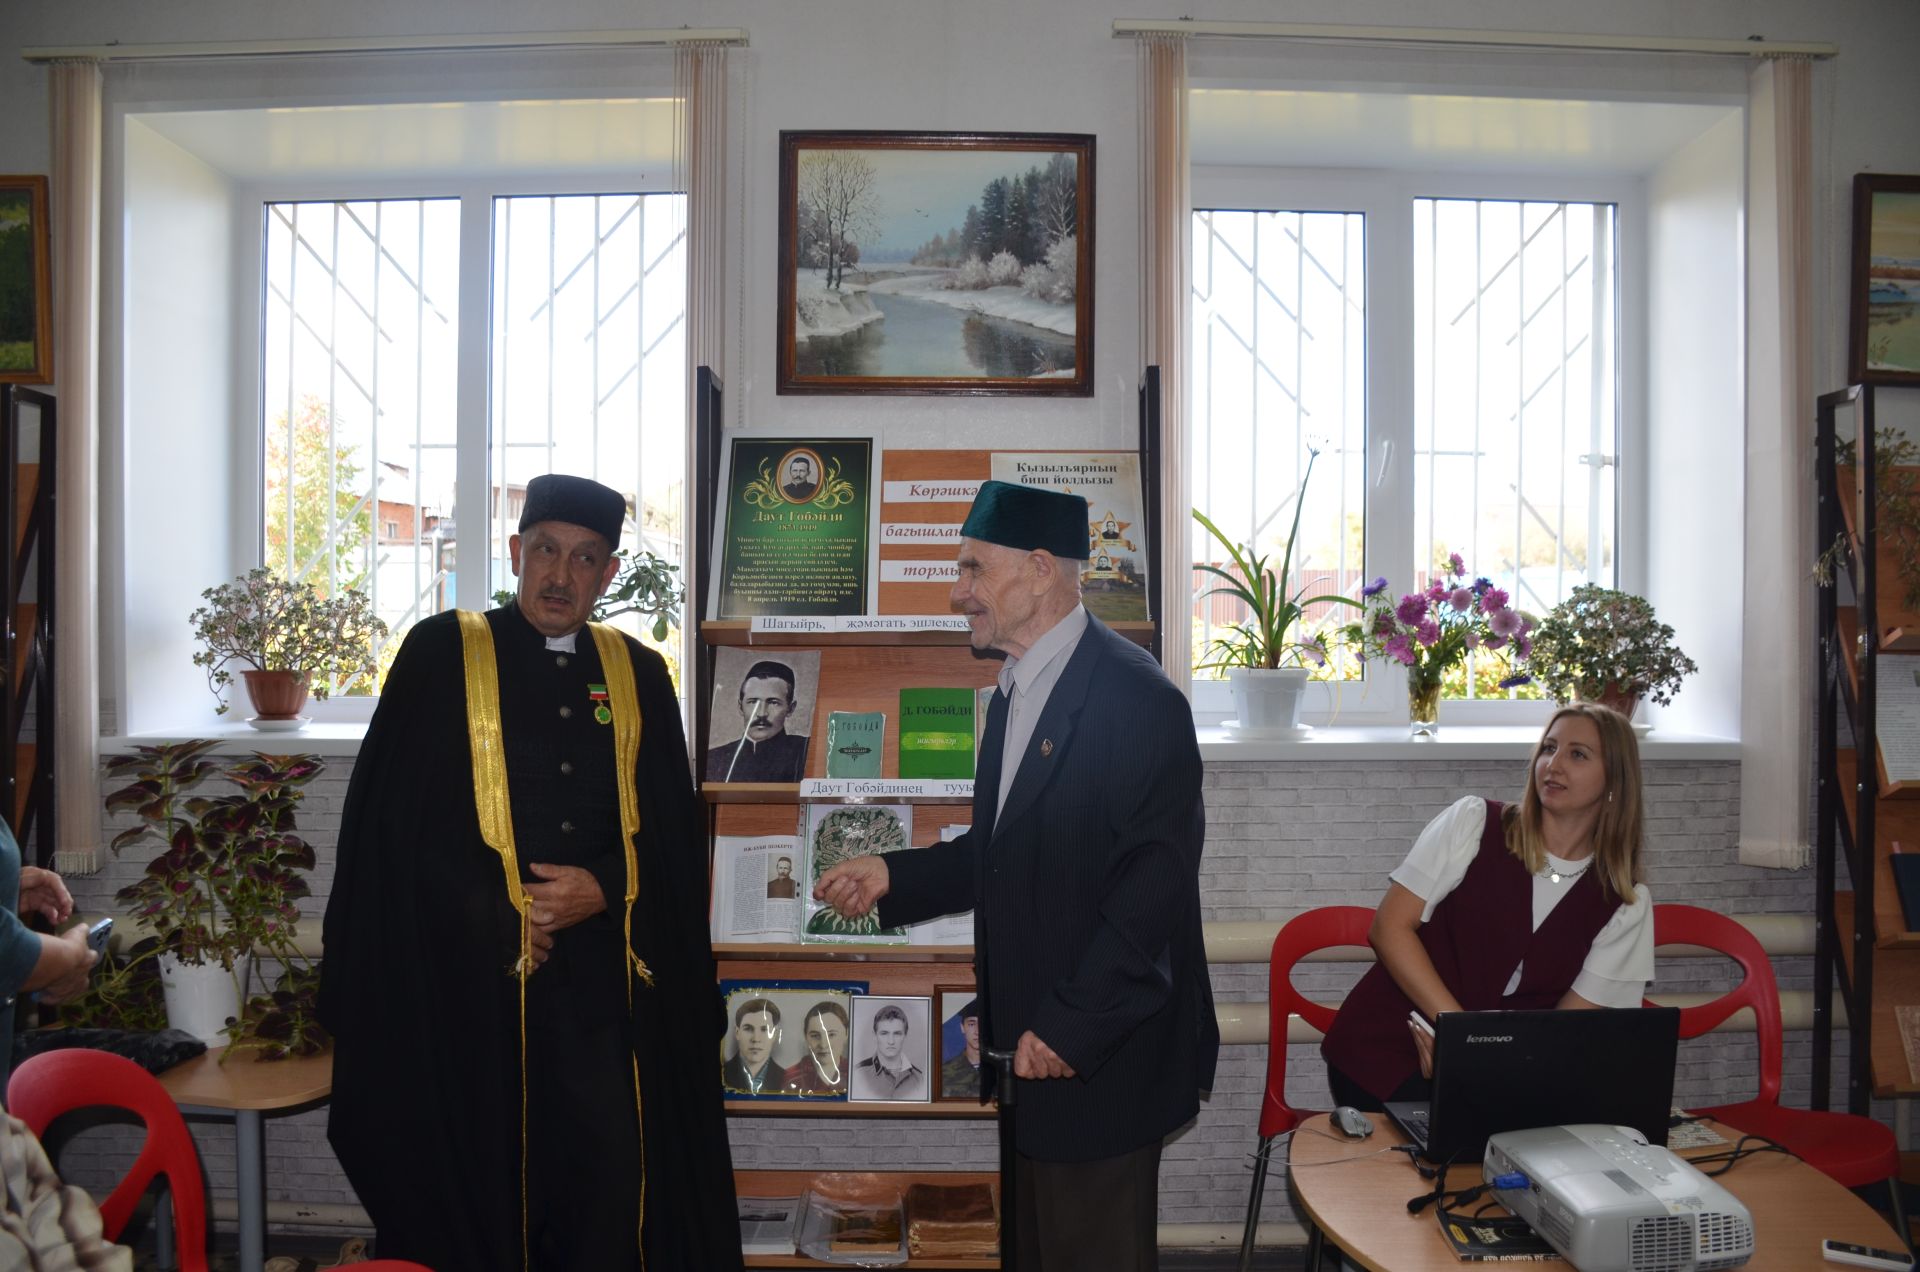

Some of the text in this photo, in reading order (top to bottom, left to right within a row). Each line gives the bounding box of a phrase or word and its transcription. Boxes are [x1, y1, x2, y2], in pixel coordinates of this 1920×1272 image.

[1021, 475, 1113, 485] биш йолдызы
[909, 484, 979, 499] Көрәшкә
[885, 525, 962, 537] багышлан
[903, 566, 962, 579] тормы
[762, 618, 826, 631] Шагыйрь,
[909, 619, 970, 628] эшлеклес
[811, 782, 975, 795] Даут Гобәйдинең тууы
[1466, 1034, 1513, 1043] lenovo
